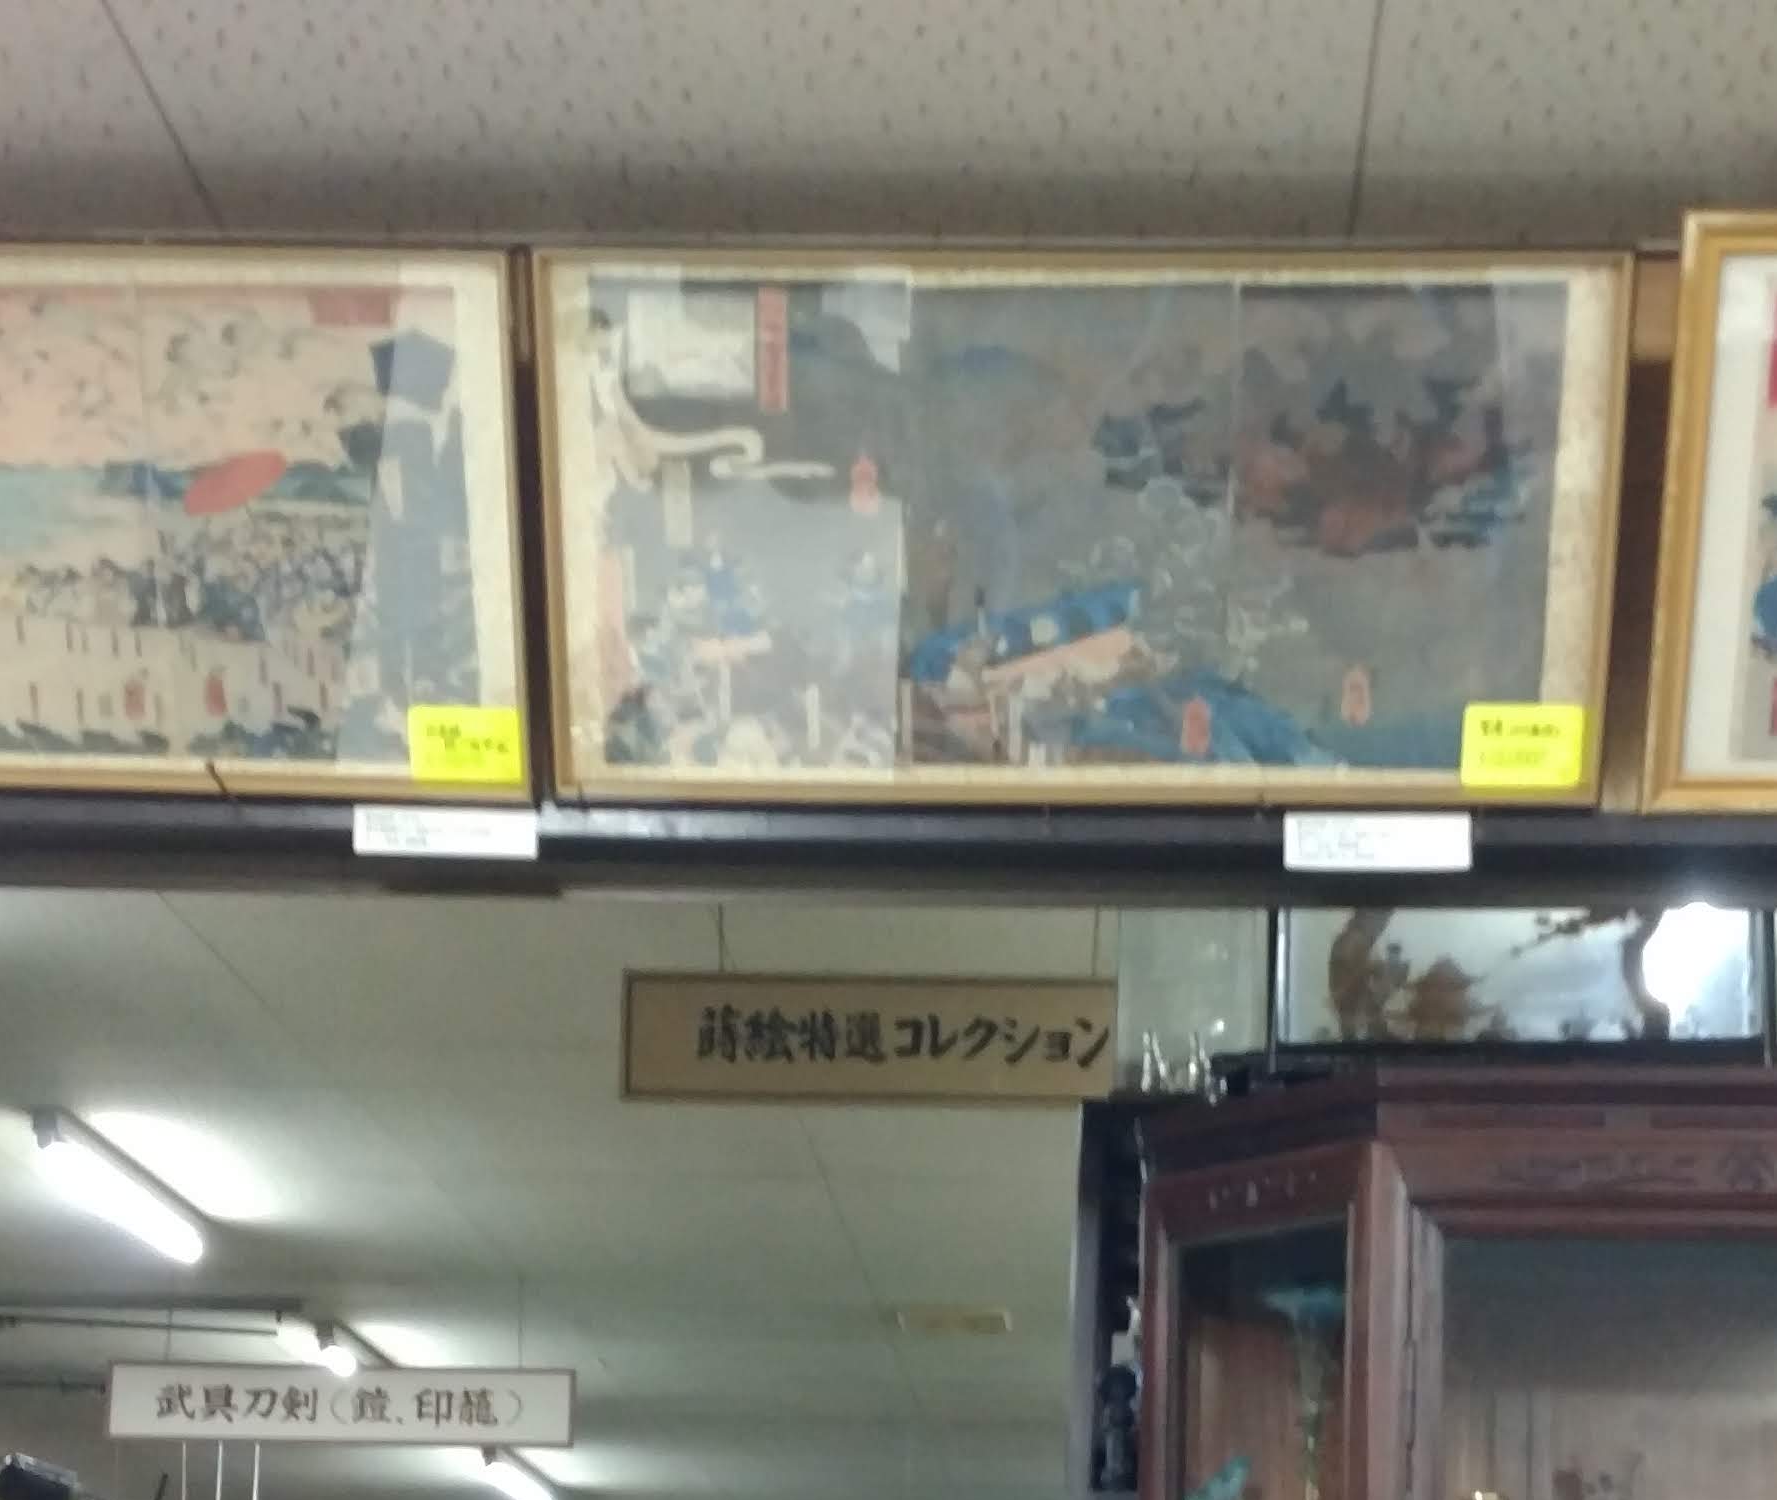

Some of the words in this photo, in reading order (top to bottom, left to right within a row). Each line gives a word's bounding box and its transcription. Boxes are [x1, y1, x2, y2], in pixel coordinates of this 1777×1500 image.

[696, 1003, 1111, 1069] 蒔絵特選コレクション
